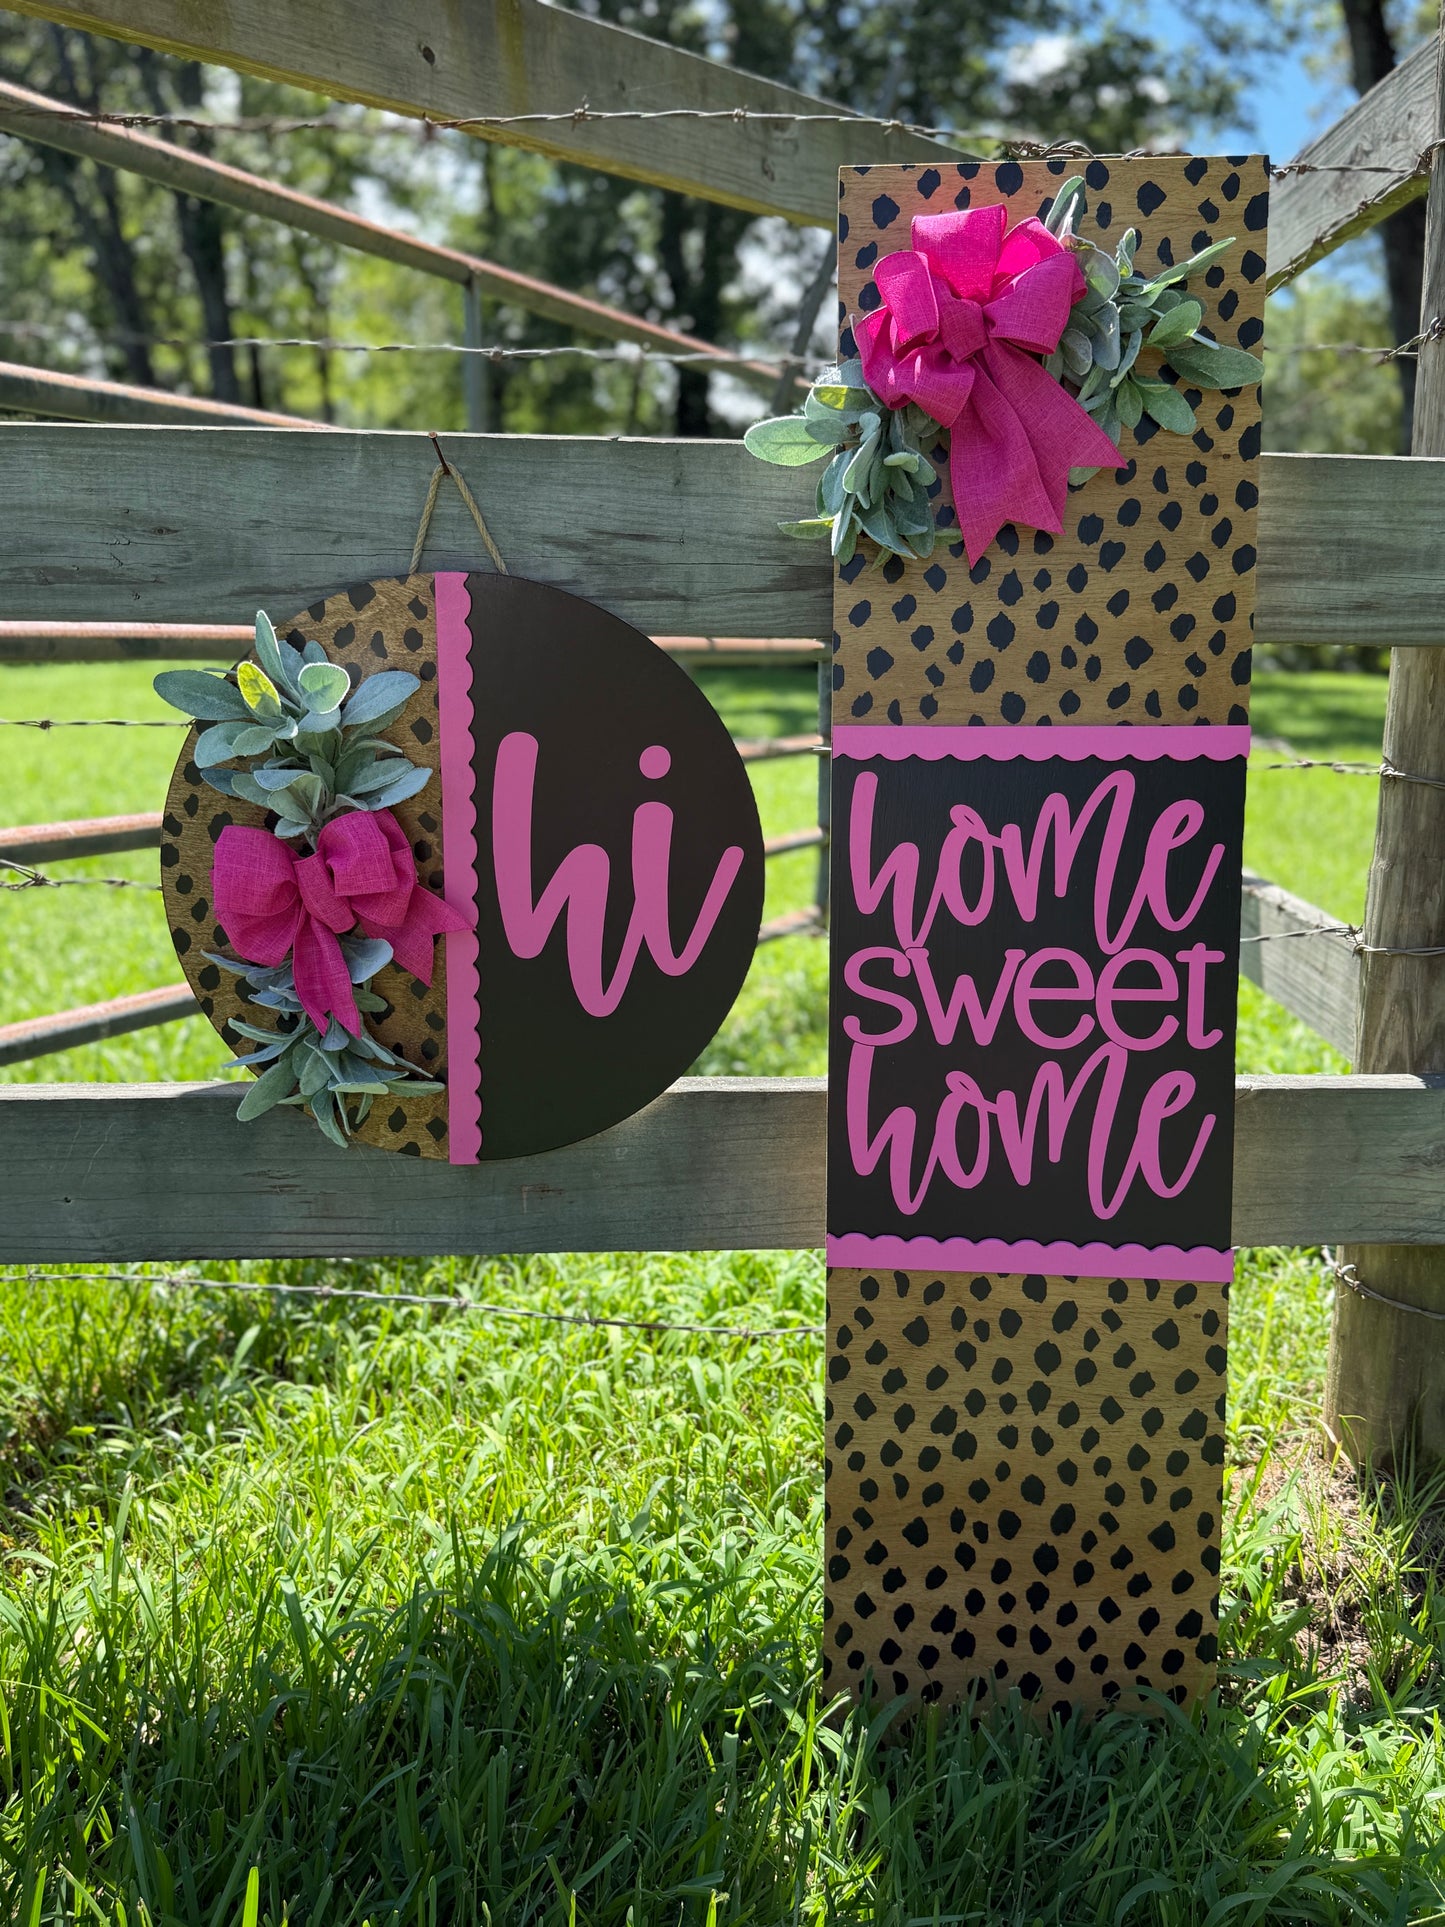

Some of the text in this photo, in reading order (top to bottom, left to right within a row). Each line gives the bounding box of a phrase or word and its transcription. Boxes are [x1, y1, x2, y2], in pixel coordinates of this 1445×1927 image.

[492, 731, 745, 1018] hi
[849, 769, 1227, 955] home
[842, 942, 1226, 1051] sweet
[846, 1041, 1217, 1220] home
